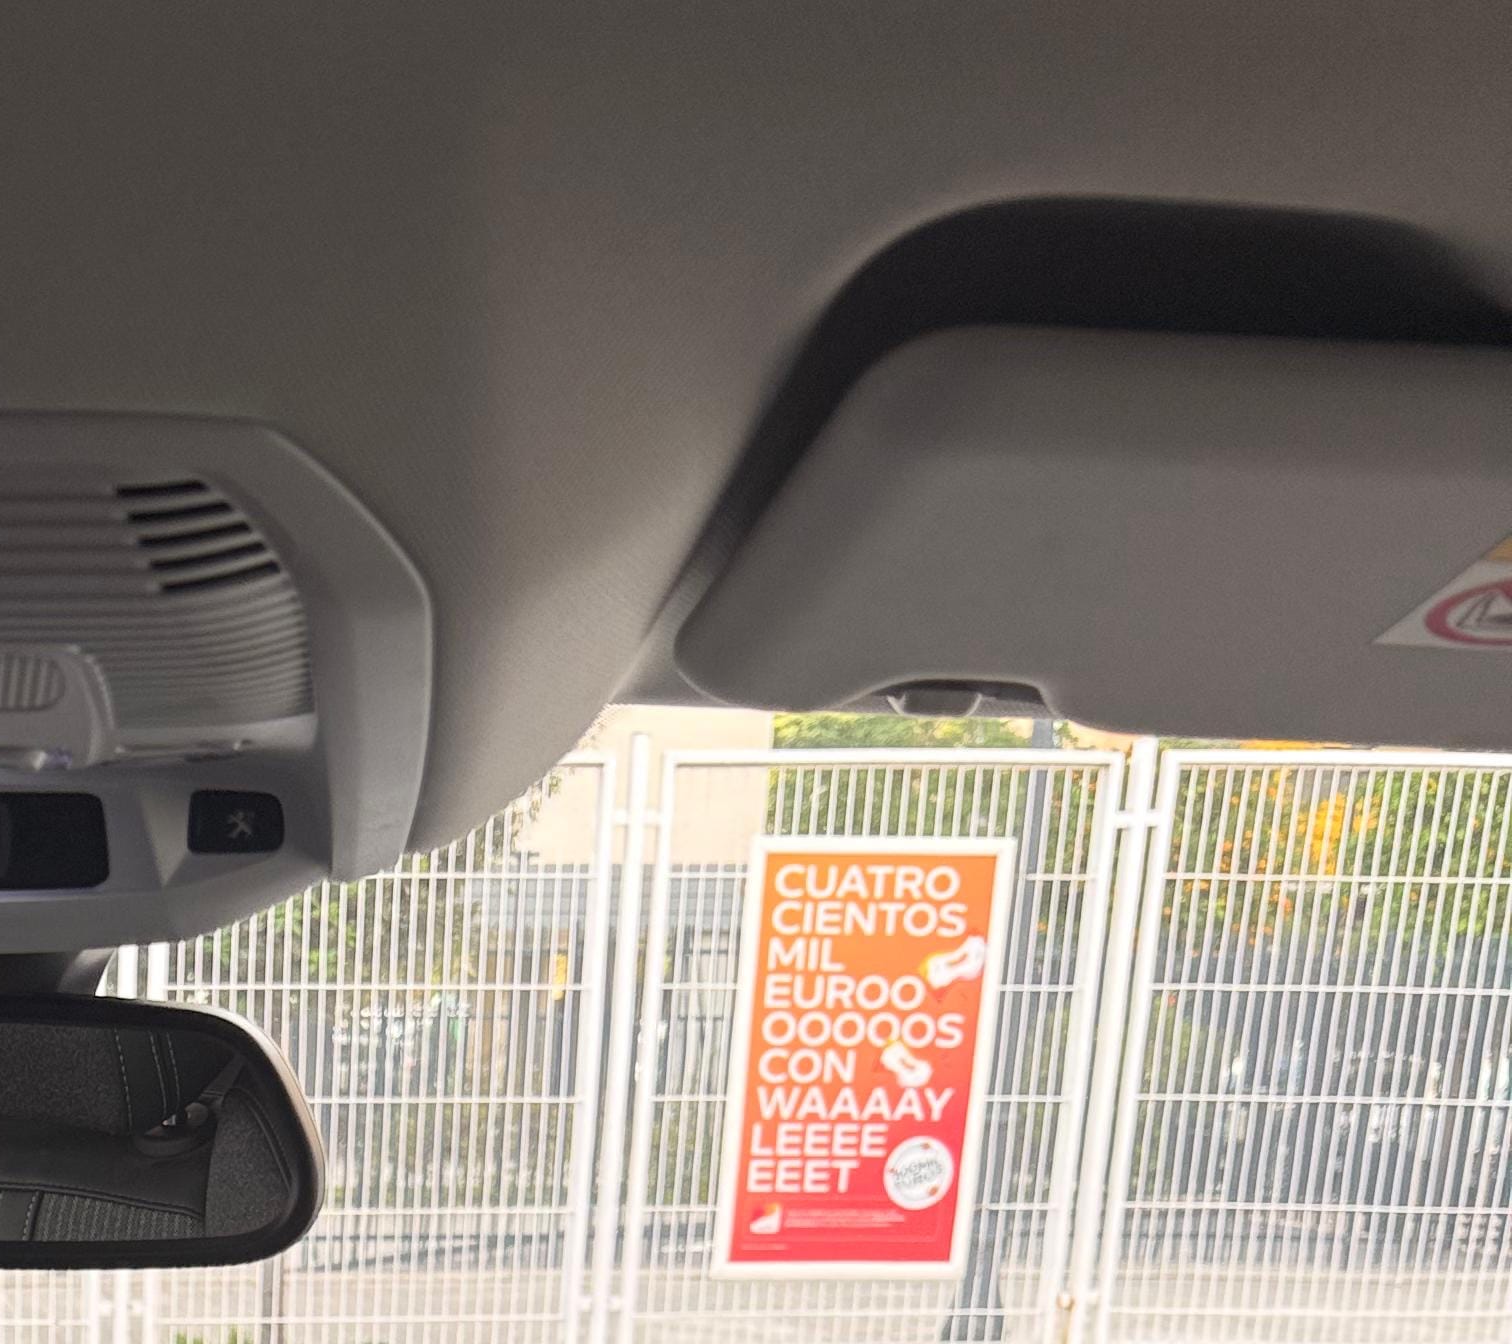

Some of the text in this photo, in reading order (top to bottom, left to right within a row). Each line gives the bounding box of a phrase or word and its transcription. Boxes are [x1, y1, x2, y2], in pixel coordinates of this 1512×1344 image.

[774, 864, 960, 900] CUATRO
[771, 901, 968, 936] CIENTOS
[767, 937, 846, 971] MIL
[763, 973, 926, 1010] EUROO
[761, 1012, 965, 1049] OOOOOS
[757, 1049, 856, 1084] CON
[757, 1087, 954, 1122] WAAAAY
[750, 1124, 887, 1158] LEEEE
[747, 1159, 858, 1193] EEET
